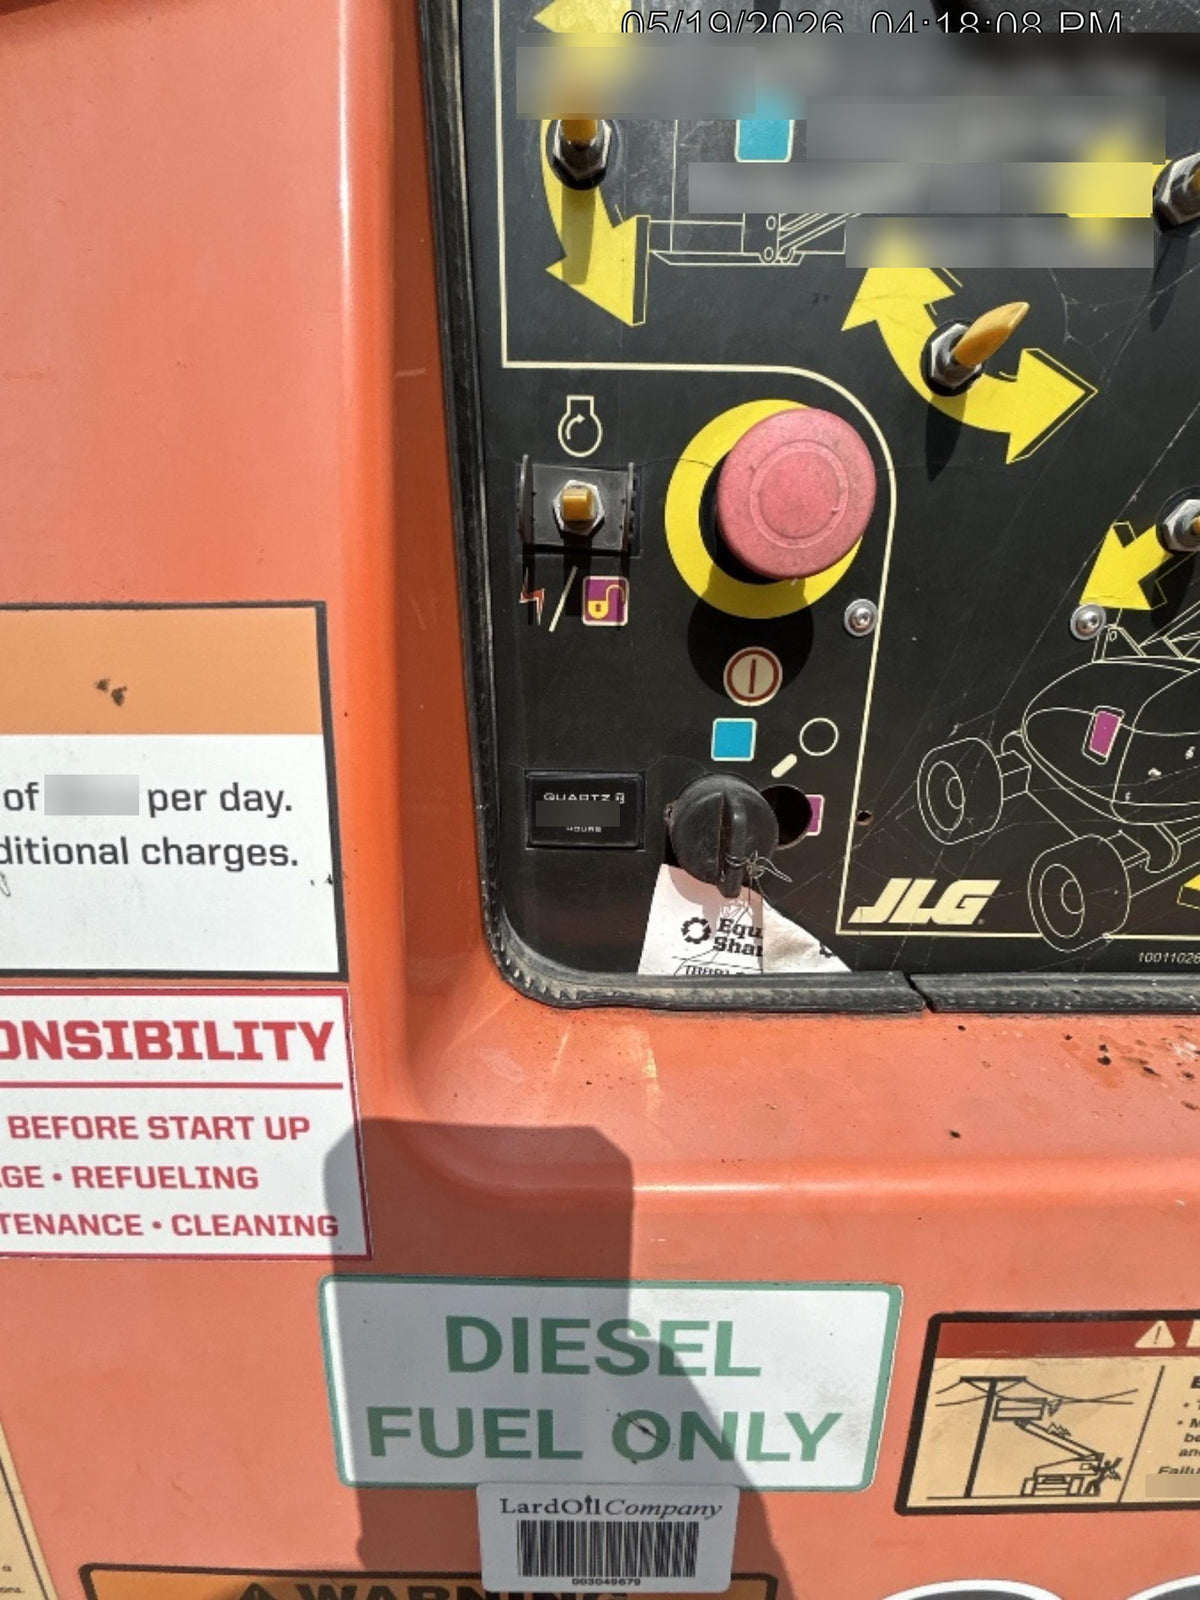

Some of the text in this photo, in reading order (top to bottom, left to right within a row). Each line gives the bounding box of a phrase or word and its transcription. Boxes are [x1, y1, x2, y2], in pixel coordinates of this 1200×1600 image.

[3, 782, 39, 811] of
[148, 789, 207, 818] per
[219, 782, 293, 818] day.
[543, 792, 611, 801] QUARTZ
[141, 836, 298, 872] charges.
[848, 877, 1000, 925] JLG
[7, 1116, 310, 1141] BEFORE START UP
[0, 1166, 259, 1189] GE REFUELING
[171, 1214, 339, 1237] CLEANING
[445, 1315, 762, 1377] DIESEL
[366, 1406, 843, 1463] FUEL ONLY
